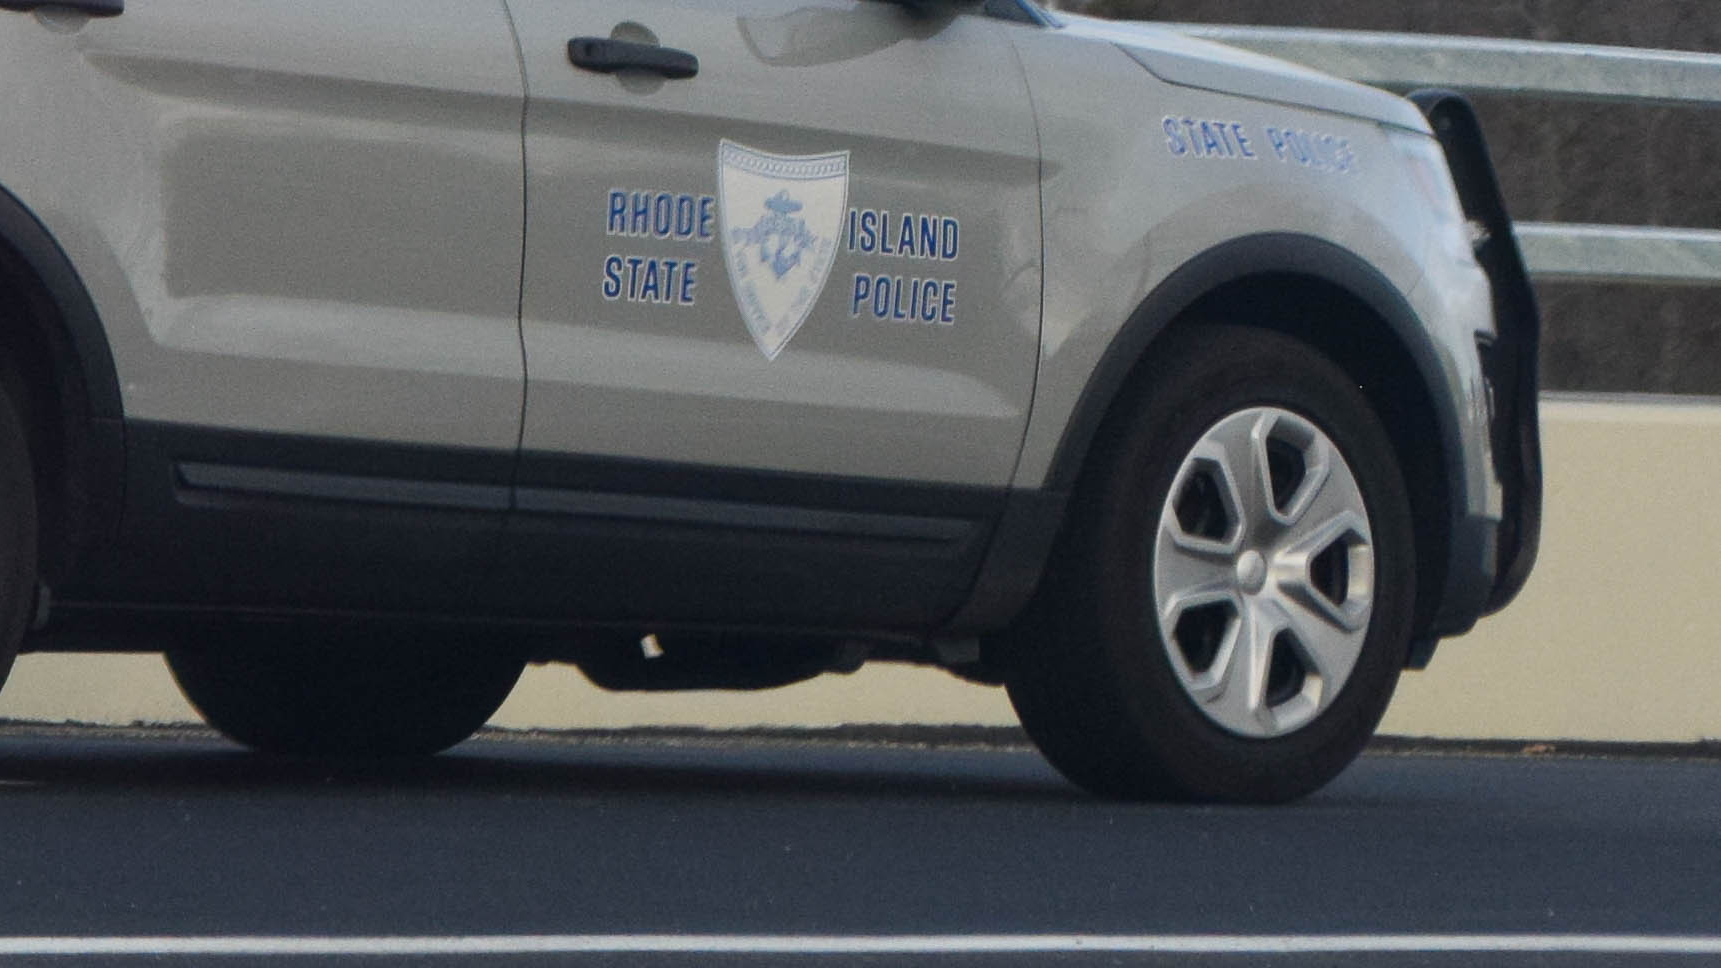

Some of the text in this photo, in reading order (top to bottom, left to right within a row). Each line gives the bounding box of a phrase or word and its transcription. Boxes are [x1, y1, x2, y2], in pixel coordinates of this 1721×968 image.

[1162, 114, 1359, 175] STATE POLC
[607, 188, 718, 242] RHODE
[846, 208, 960, 261] ISLAND
[602, 255, 700, 306] STATE
[850, 274, 958, 325] POLICE
